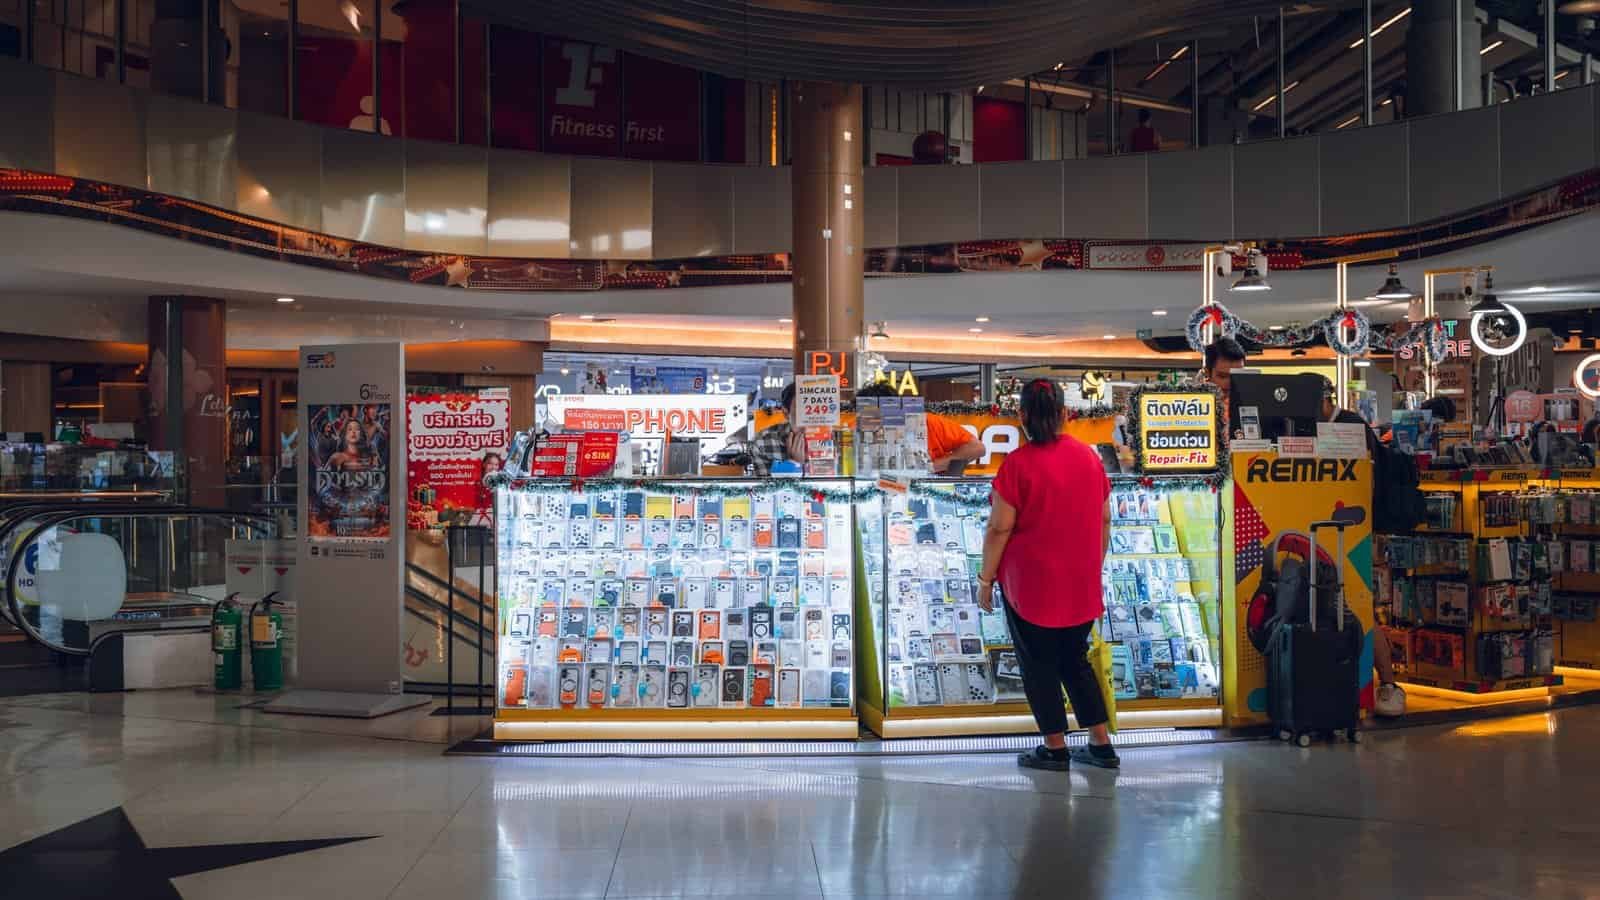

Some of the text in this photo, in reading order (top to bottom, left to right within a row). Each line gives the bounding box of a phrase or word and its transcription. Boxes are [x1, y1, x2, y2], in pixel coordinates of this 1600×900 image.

[551, 114, 665, 144] Fitness First
[810, 352, 847, 376] PJ
[811, 396, 833, 404] DAYS
[1146, 399, 1209, 416] ติดฟิล์ม
[424, 409, 494, 428] บริการห่อ
[805, 405, 828, 415] 249
[414, 430, 504, 451] ของขวัญฟรี
[1149, 432, 1208, 447] ซ่อมด่วน
[1247, 457, 1357, 482] REMAX
